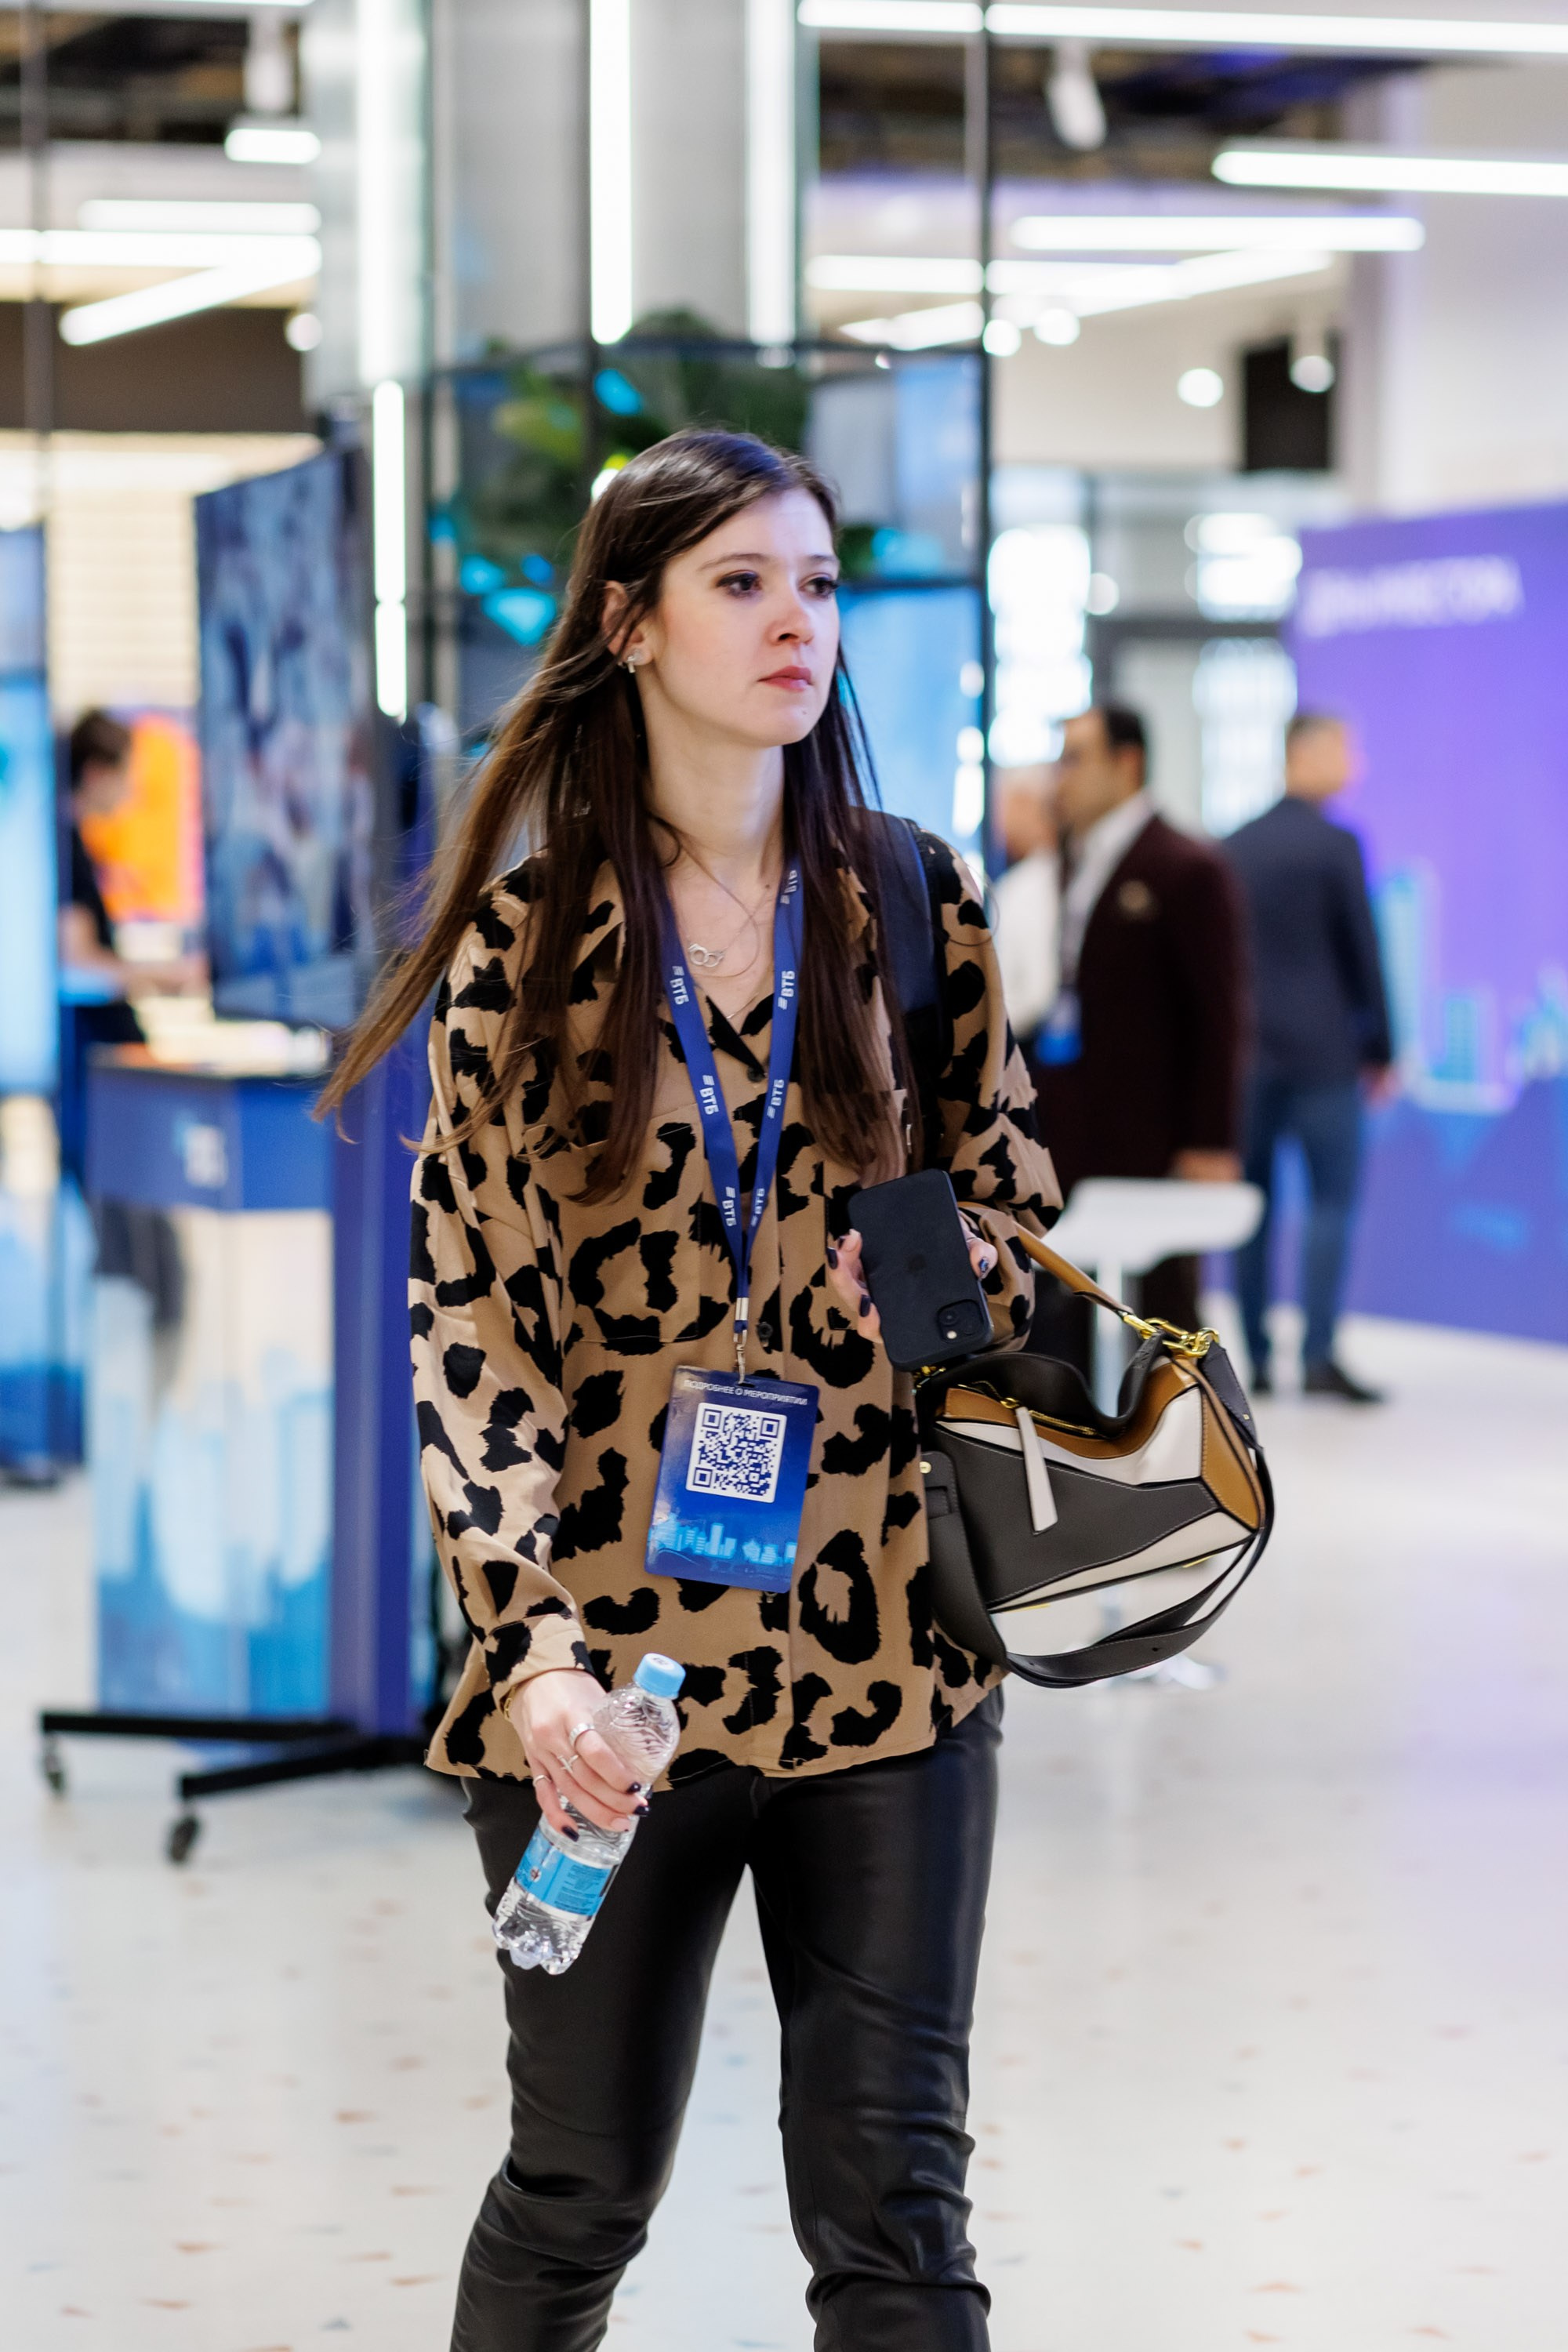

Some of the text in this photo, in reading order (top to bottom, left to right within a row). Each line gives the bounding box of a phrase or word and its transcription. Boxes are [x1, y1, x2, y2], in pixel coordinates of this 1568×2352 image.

[670, 978, 689, 1005] ВТБ
[781, 971, 796, 997] ВТБ
[699, 1087, 719, 1115] ВТБ
[771, 1079, 784, 1106] ВТБ
[722, 1200, 737, 1227] ВТБ
